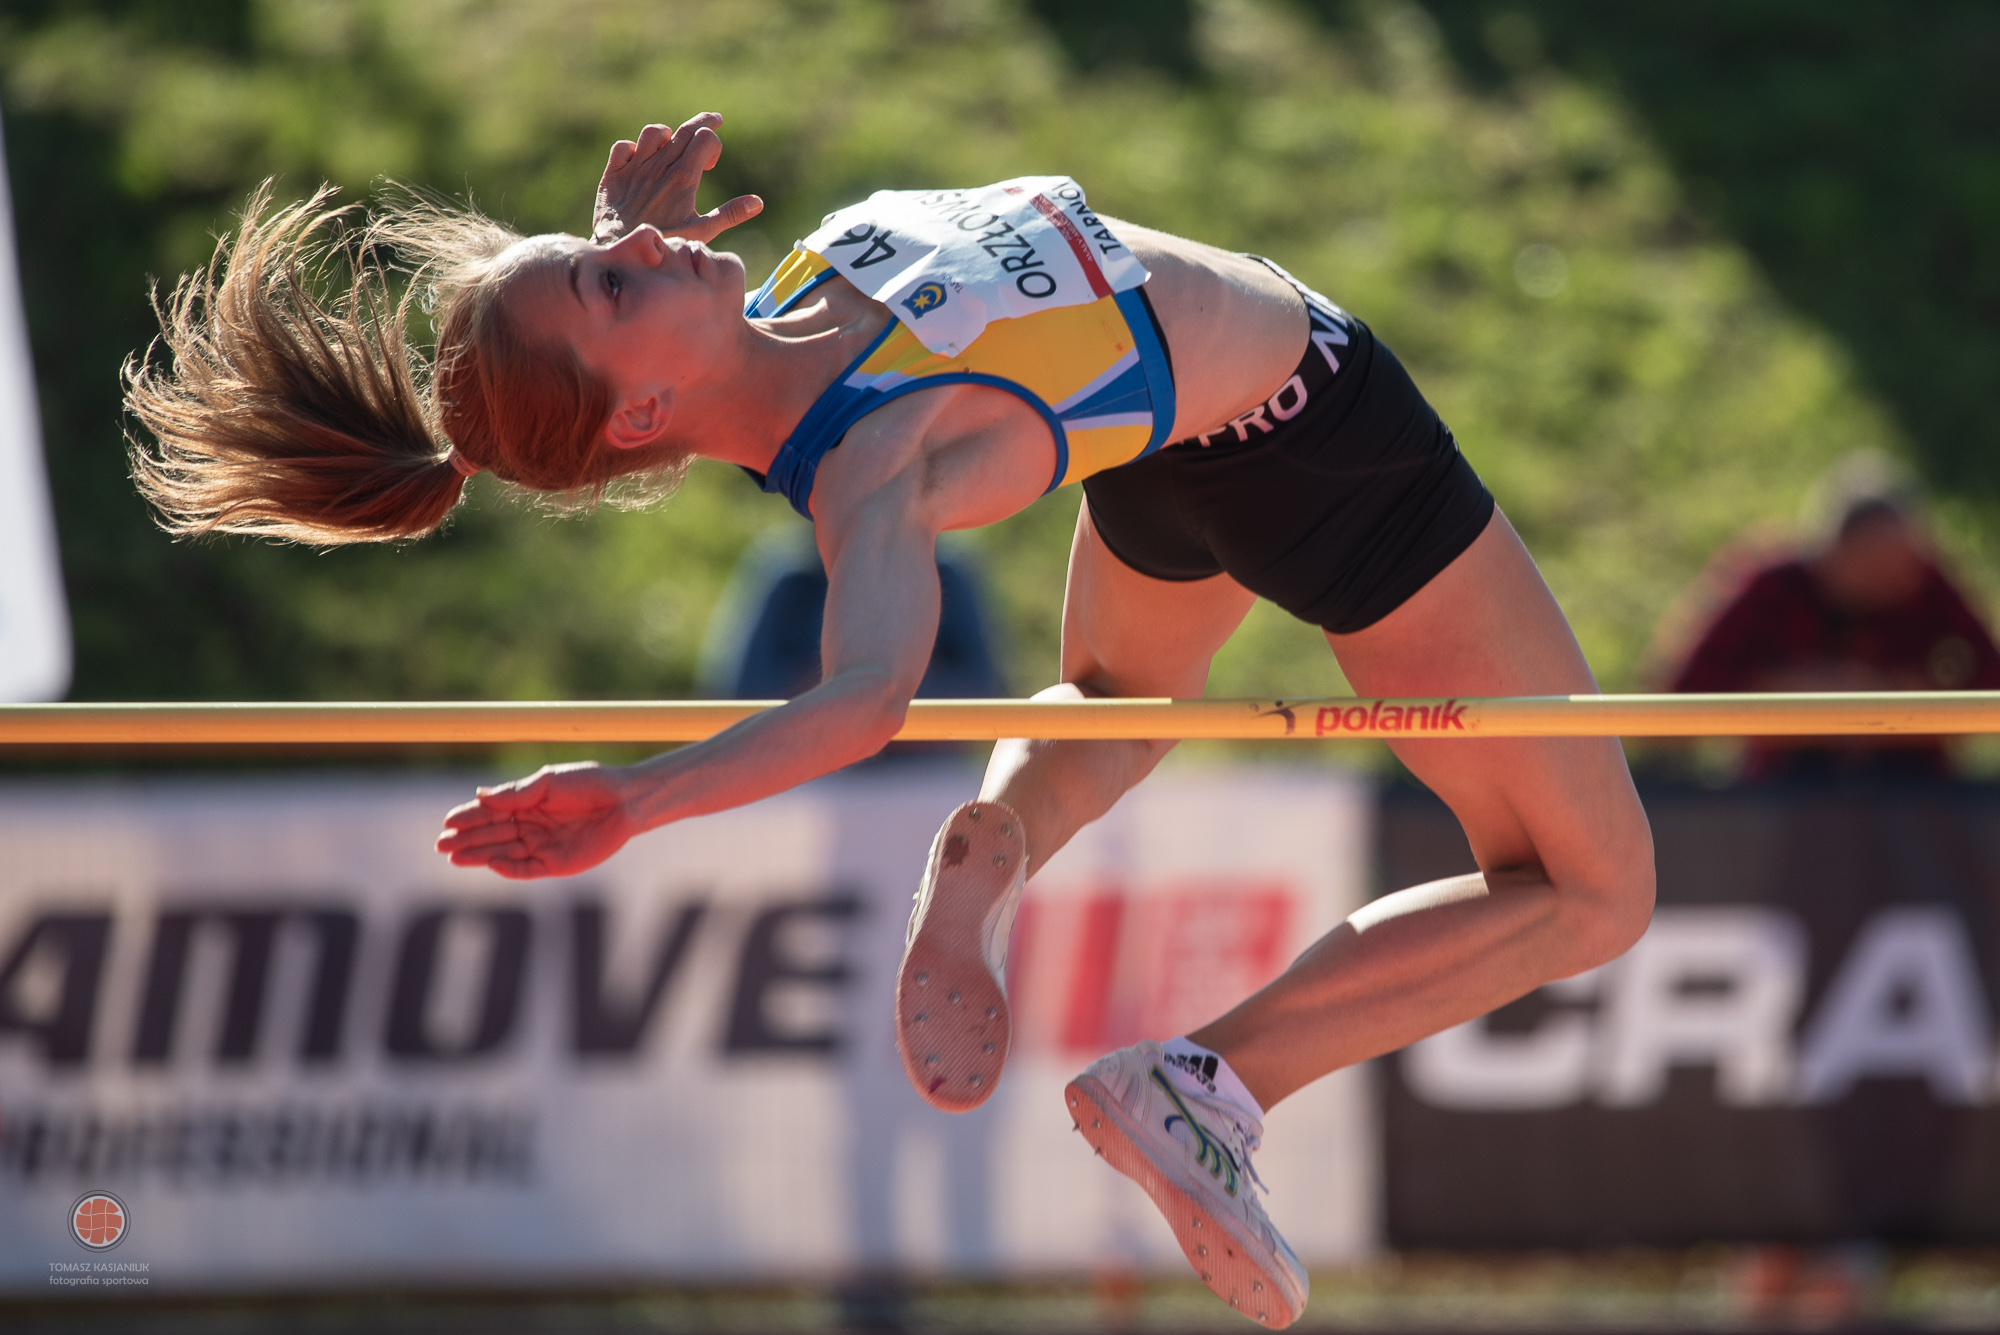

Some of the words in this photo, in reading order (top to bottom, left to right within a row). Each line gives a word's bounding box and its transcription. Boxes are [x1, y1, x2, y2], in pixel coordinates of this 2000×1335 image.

[913, 190, 1057, 299] ORZŁOWS
[1052, 182, 1122, 255] TARNÓ
[1315, 699, 1468, 737] polanik
